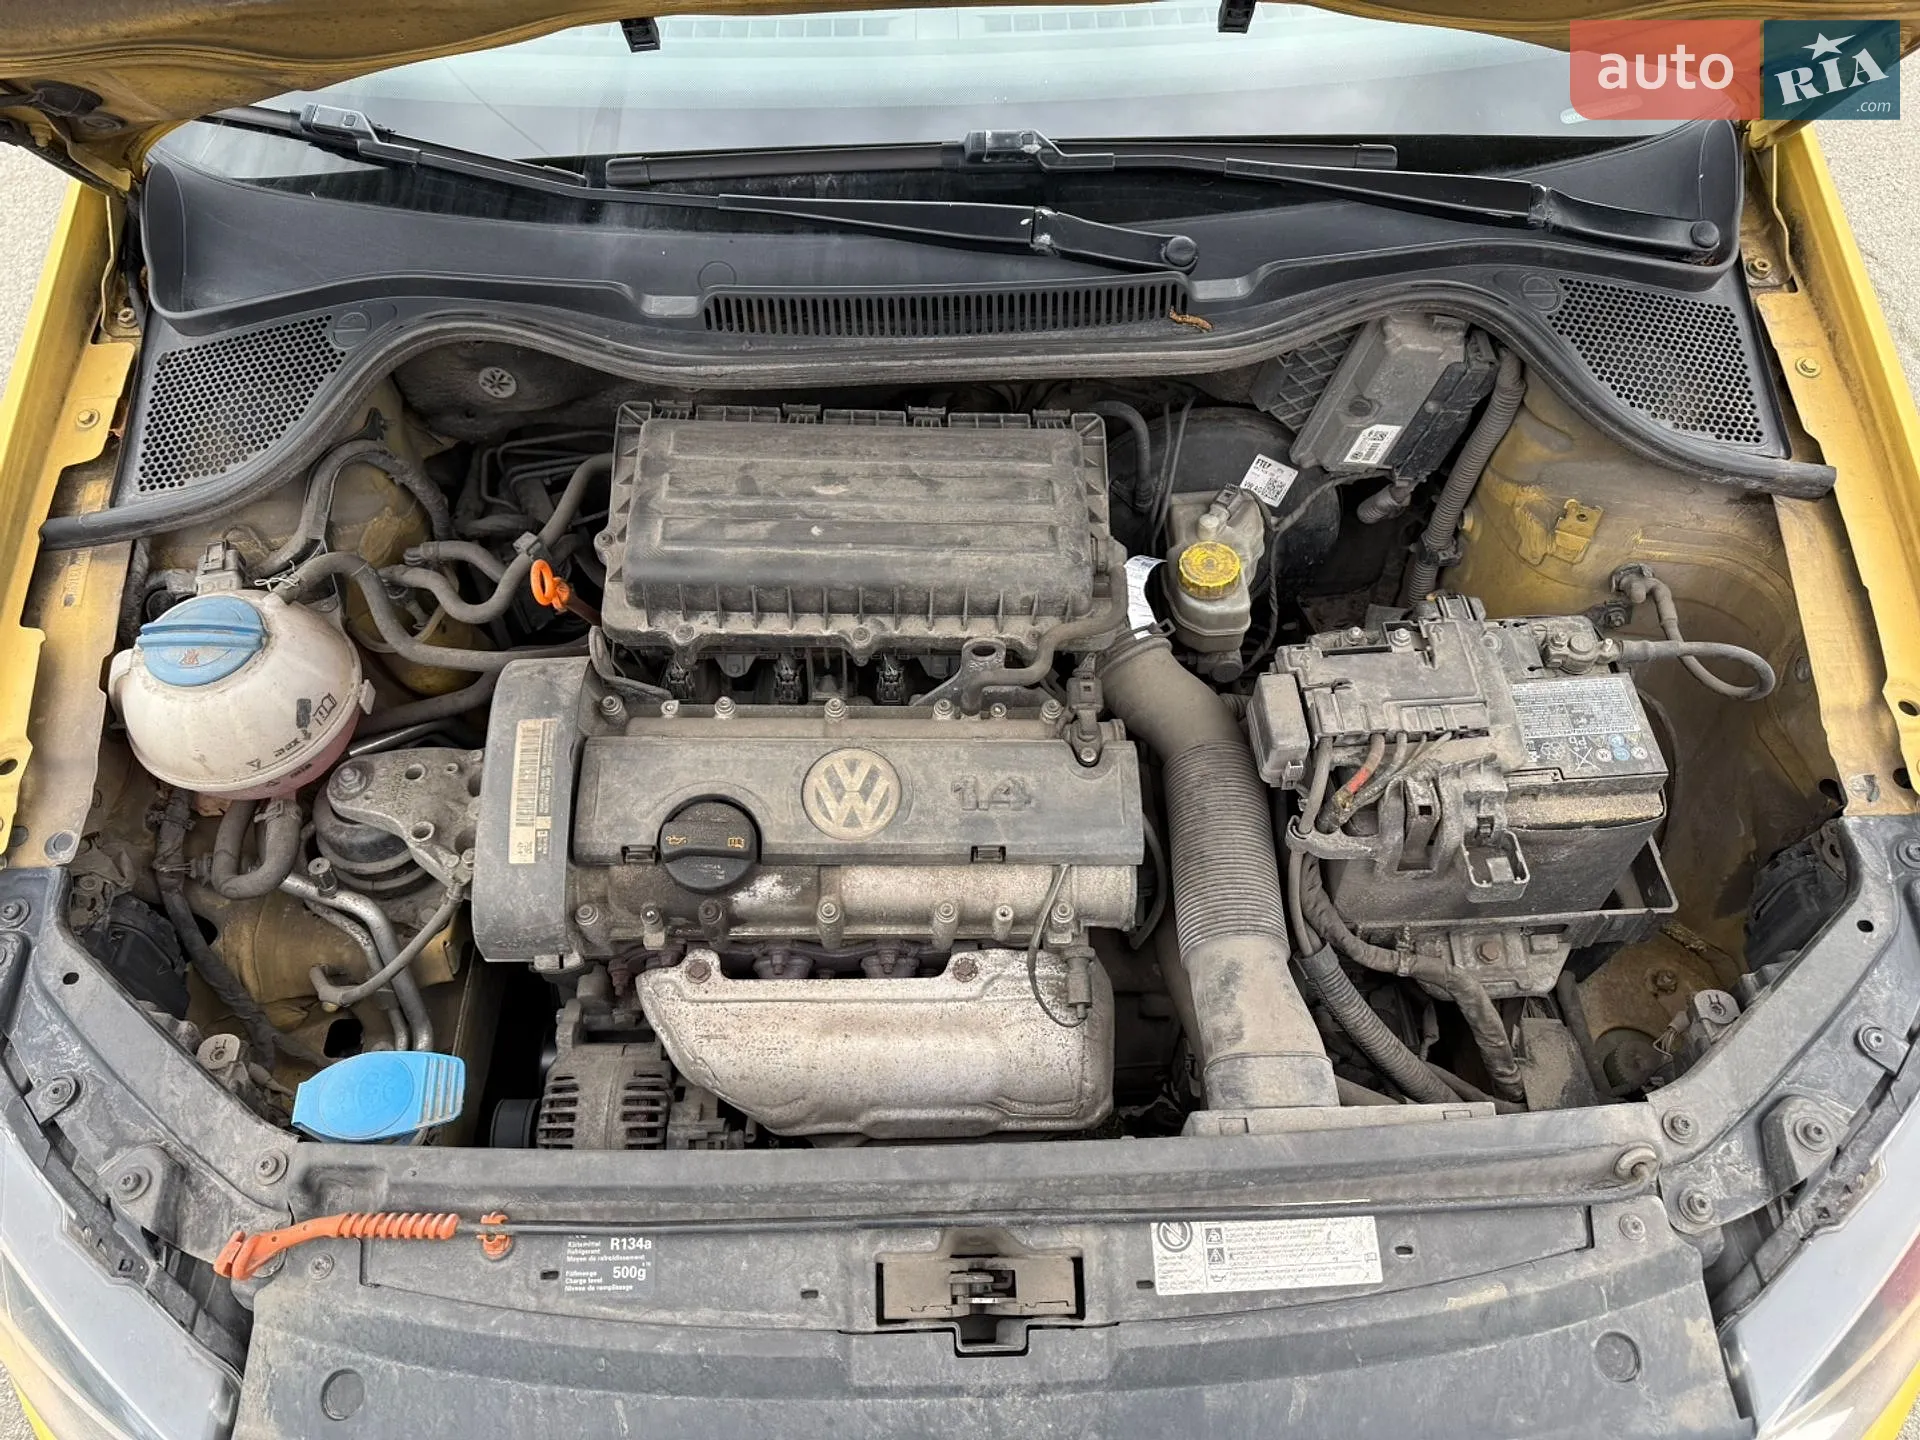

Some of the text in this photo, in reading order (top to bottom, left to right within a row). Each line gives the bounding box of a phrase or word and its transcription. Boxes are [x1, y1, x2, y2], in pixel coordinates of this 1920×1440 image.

[952, 774, 1031, 811] 1.4
[610, 1237, 652, 1251] R134a
[612, 1265, 647, 1281] 500g
